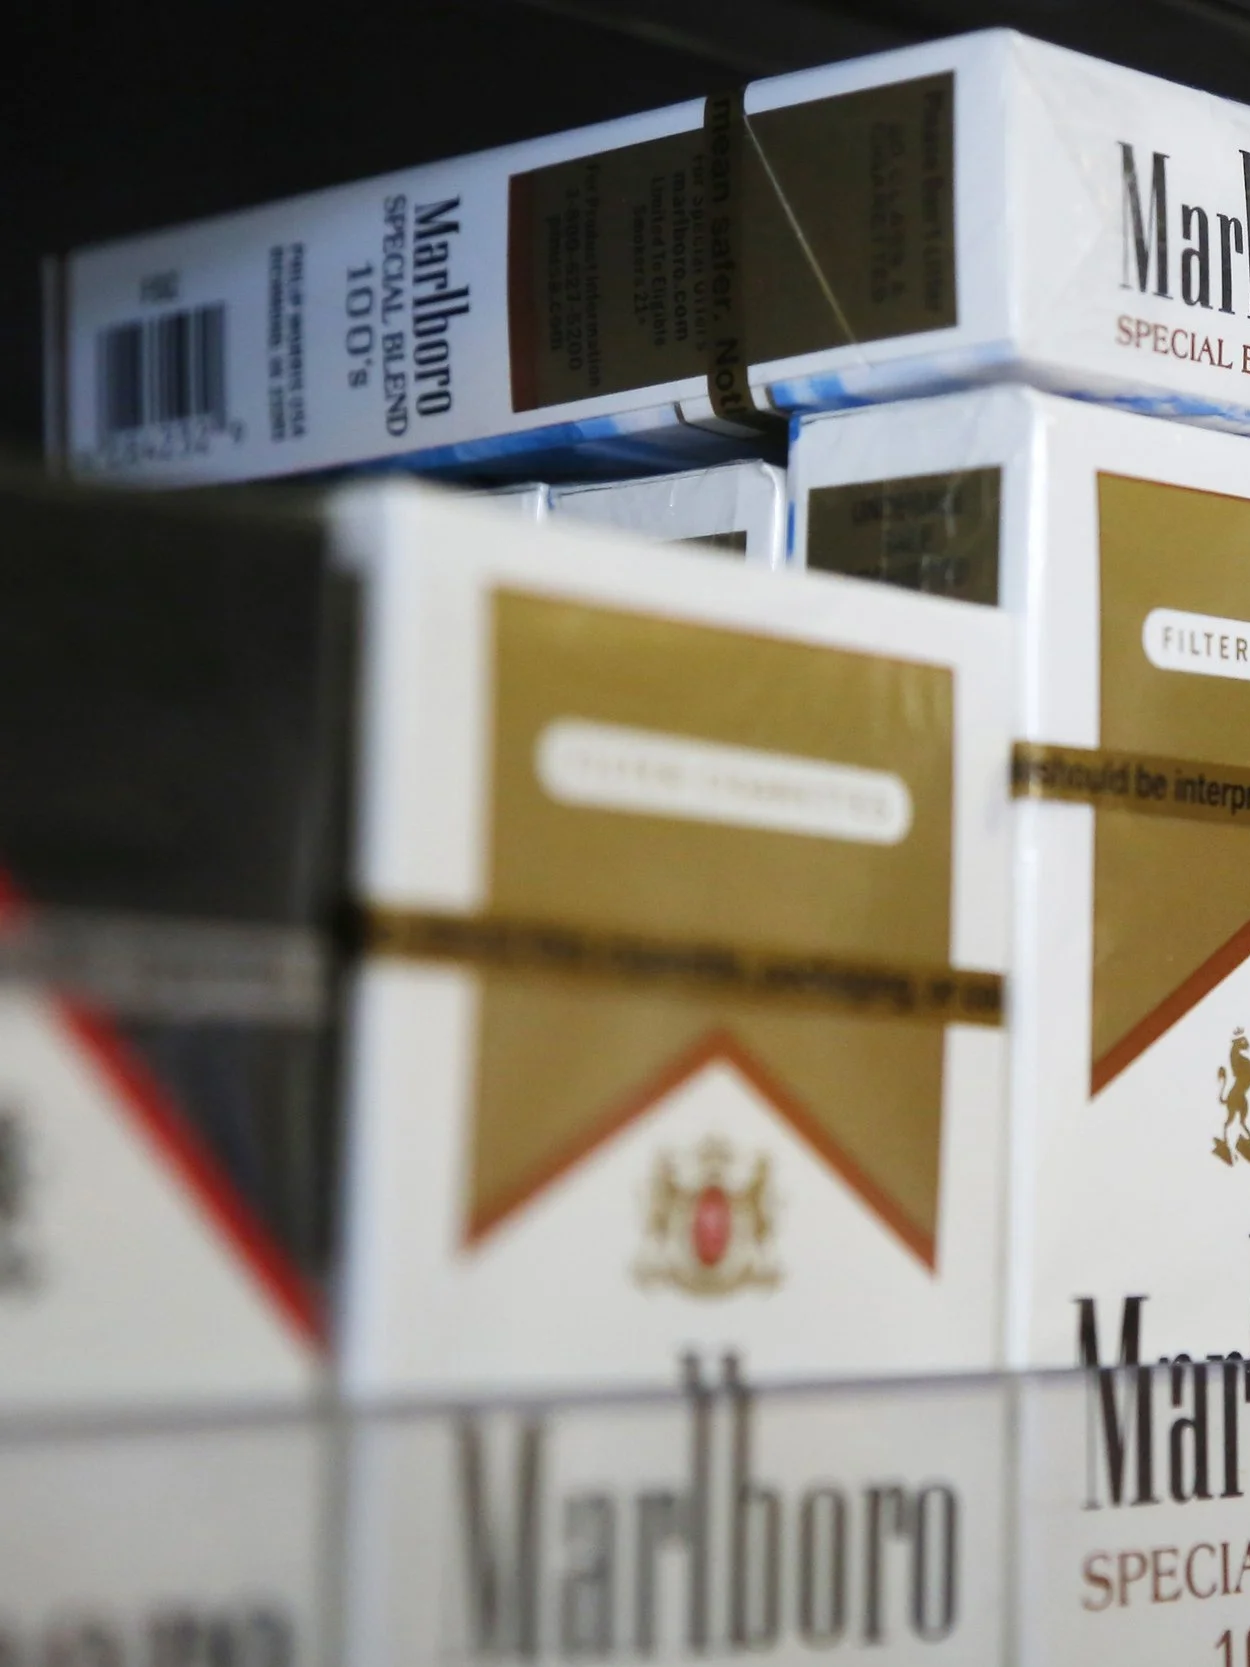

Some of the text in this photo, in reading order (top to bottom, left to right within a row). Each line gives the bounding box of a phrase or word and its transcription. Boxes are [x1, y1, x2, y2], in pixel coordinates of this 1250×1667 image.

[710, 100, 733, 203] mean
[412, 195, 470, 417] Marlboro
[584, 162, 603, 390] For Product Information
[632, 203, 648, 287] Smokers
[648, 175, 668, 348] Limited To Eligible
[672, 170, 690, 342] marlboro.com
[710, 216, 735, 322] safer.
[345, 263, 375, 390] 100's
[382, 194, 408, 437] SPECIAL BLEND
[1115, 314, 1234, 370] SPECIAL
[1161, 626, 1249, 663] FILTER
[1134, 763, 1168, 799] be
[443, 1350, 960, 1664] Marlboro
